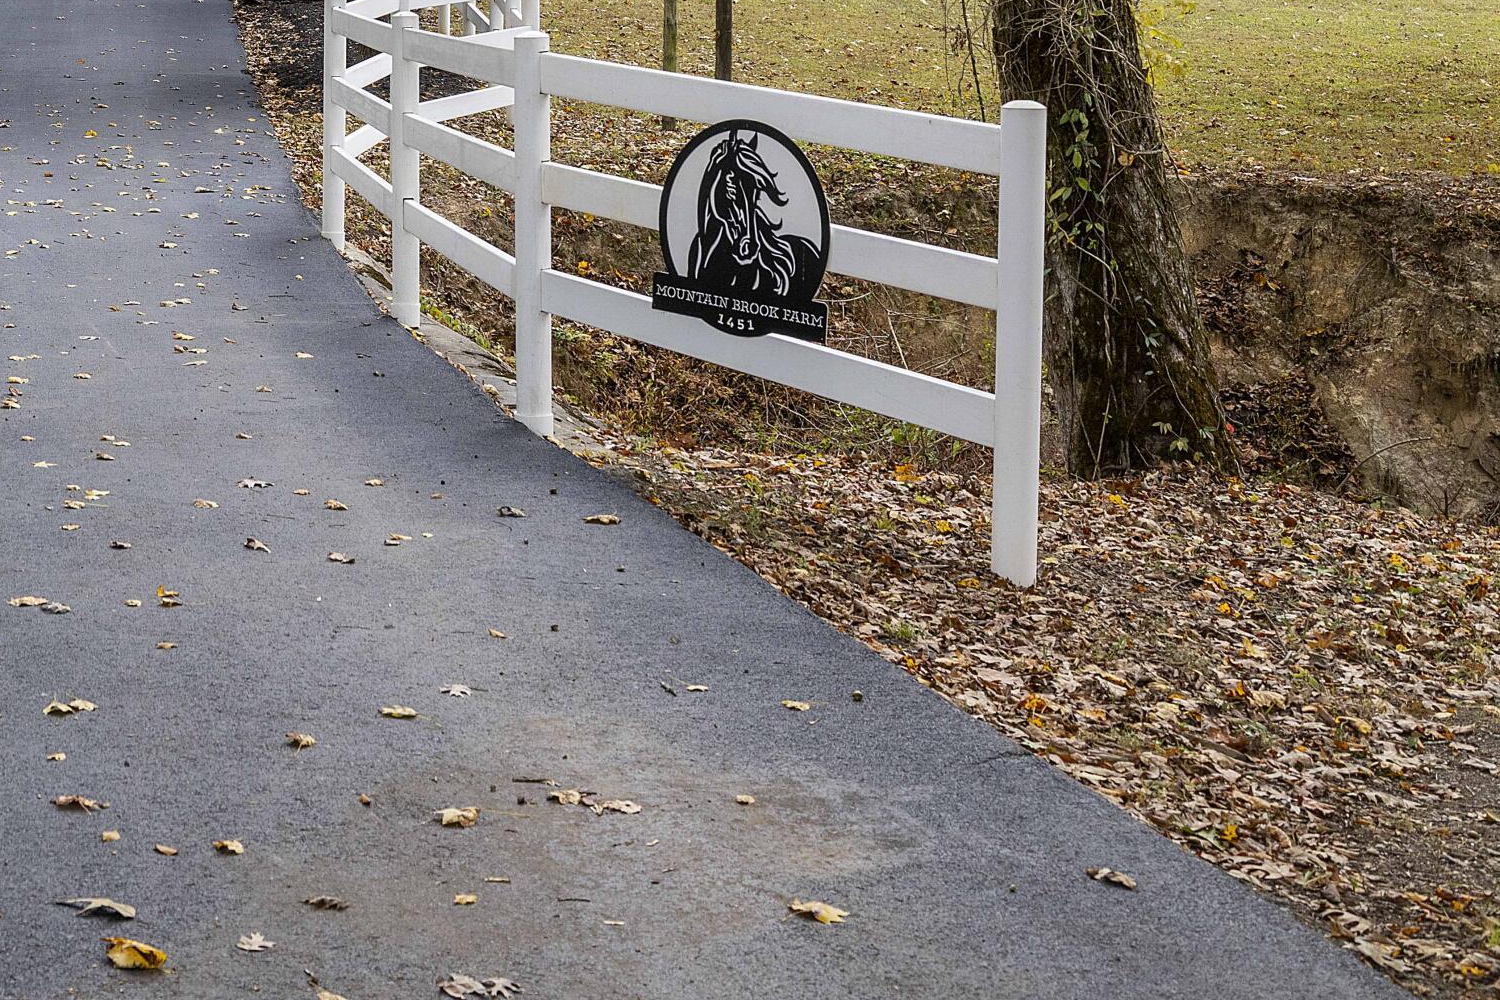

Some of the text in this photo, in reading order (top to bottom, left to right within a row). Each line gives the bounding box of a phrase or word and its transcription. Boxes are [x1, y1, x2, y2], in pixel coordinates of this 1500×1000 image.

[655, 284, 824, 328] MOUNTAIN BROOK FARM
[717, 313, 755, 330] 1451
